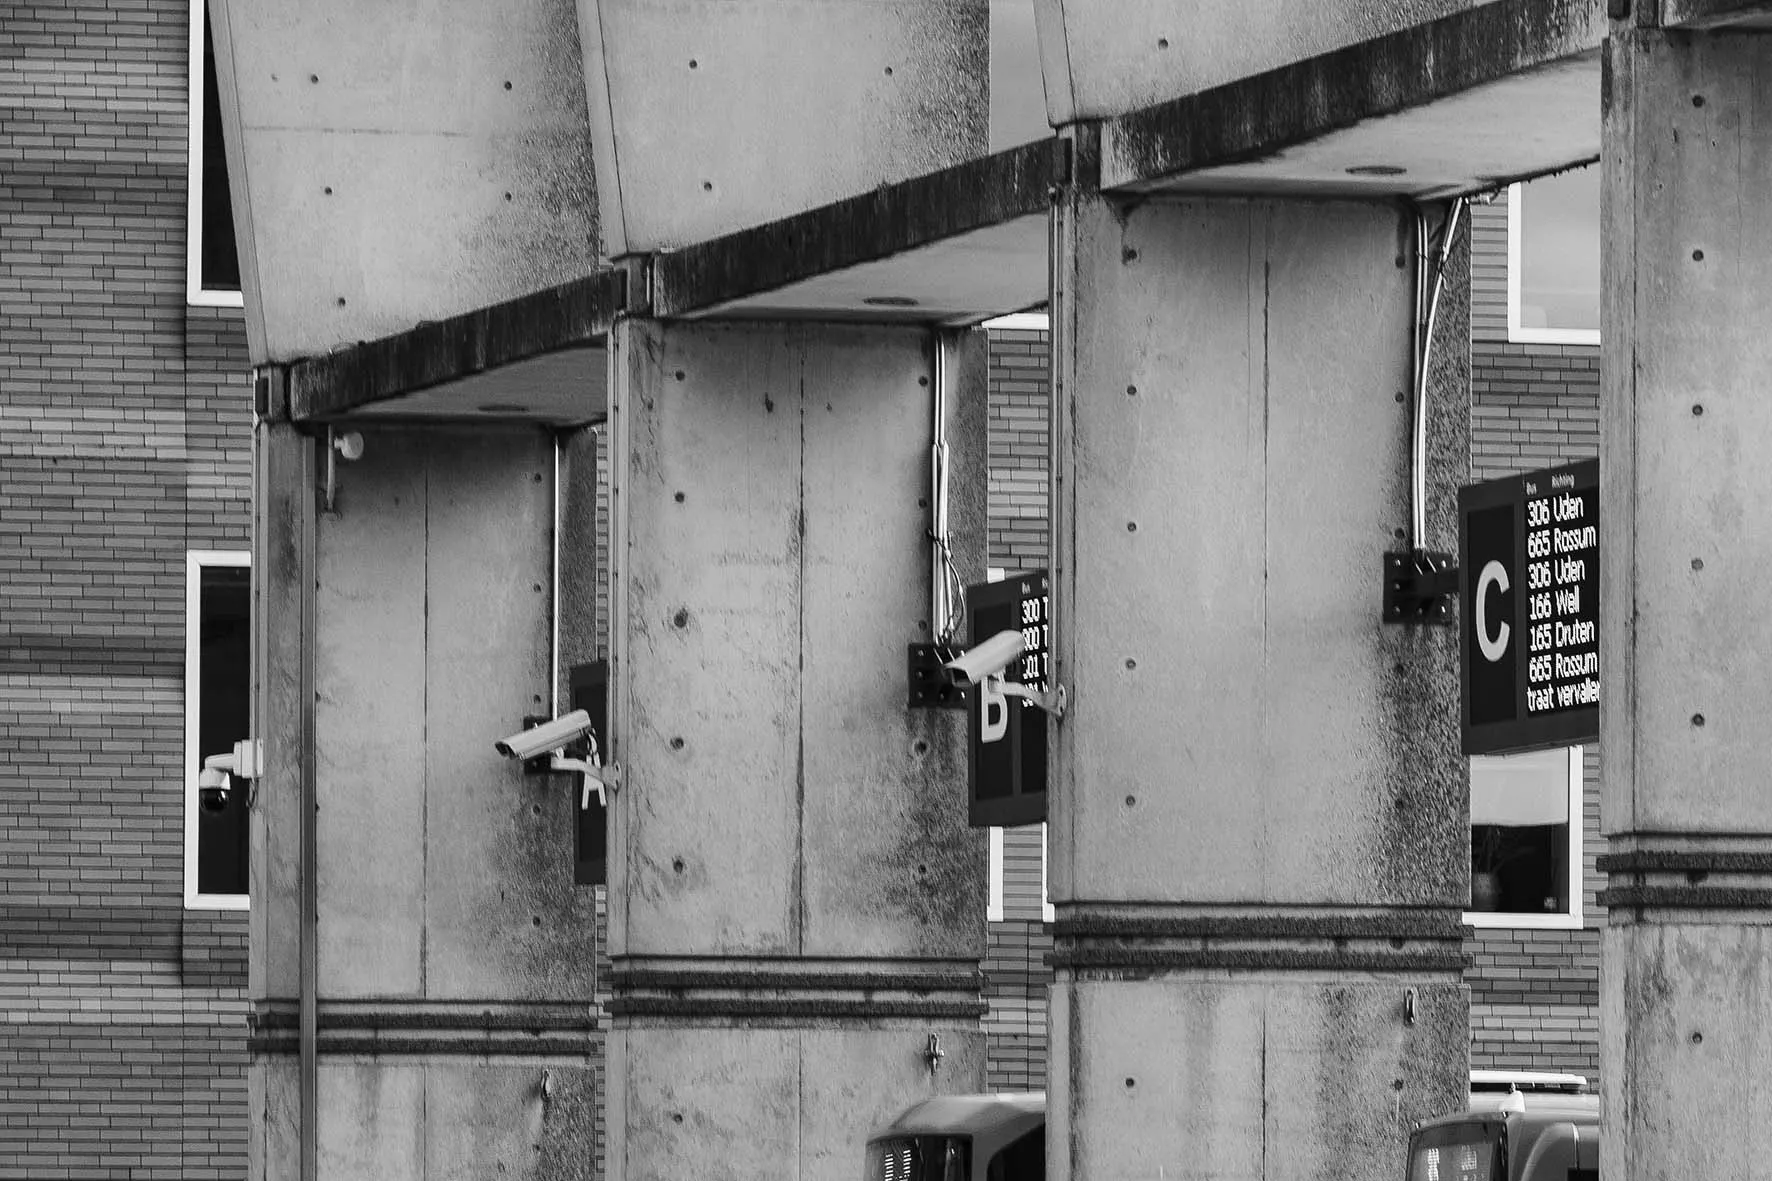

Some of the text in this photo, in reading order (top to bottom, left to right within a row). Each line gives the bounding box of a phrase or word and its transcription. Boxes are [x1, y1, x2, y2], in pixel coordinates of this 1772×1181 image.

[1527, 492, 1584, 528] 306 Uden
[1527, 524, 1597, 559] 665 Rossum
[1528, 555, 1586, 590] 306 Uden
[1475, 559, 1511, 663] C
[1529, 593, 1552, 621] 166
[1529, 617, 1595, 652] 165 Druten
[1529, 651, 1599, 683] 665 Rossum
